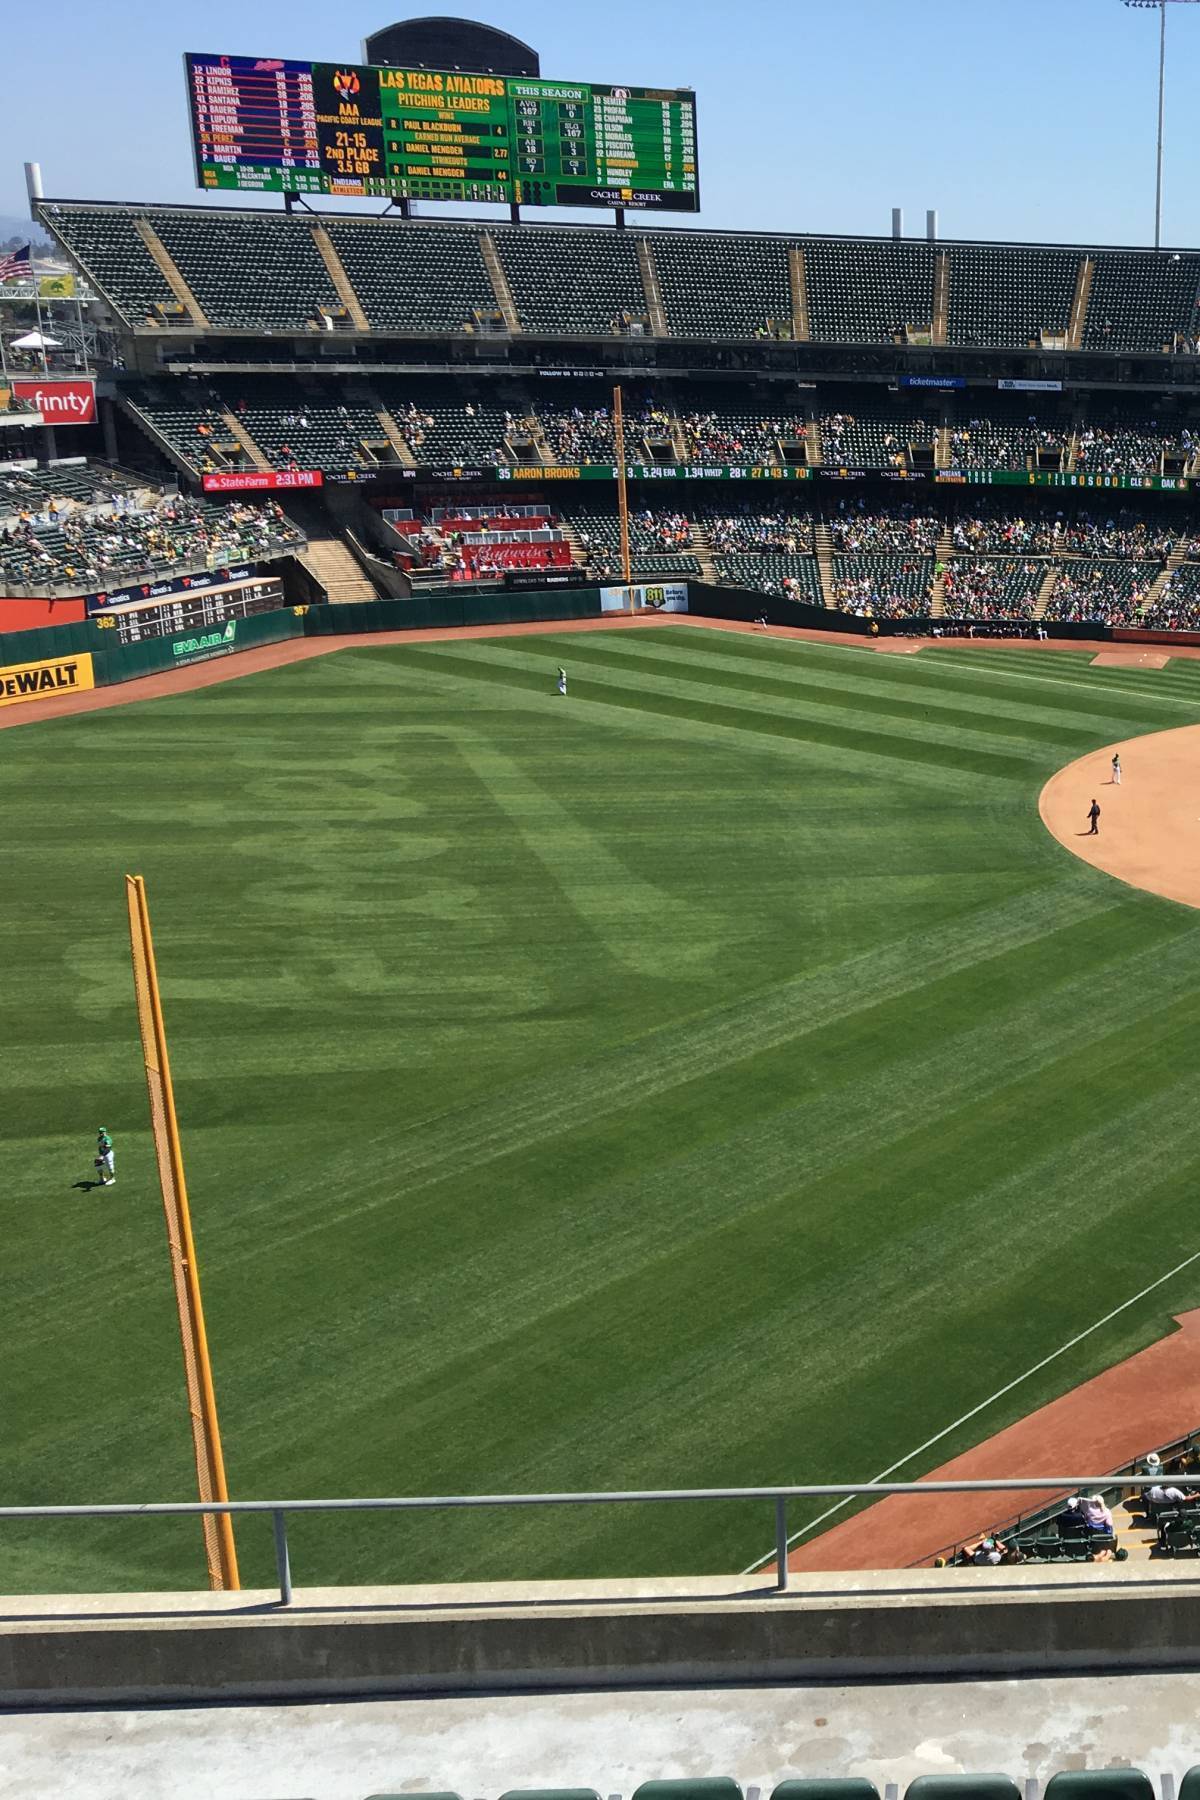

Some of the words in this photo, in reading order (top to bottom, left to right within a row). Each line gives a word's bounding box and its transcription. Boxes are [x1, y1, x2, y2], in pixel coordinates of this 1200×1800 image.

[194, 65, 203, 74] 12
[206, 66, 232, 76] LINDOR
[195, 76, 204, 84] 22
[206, 76, 232, 86] KIPNIS
[379, 70, 404, 89] LAS
[407, 72, 442, 91] VEGAS
[446, 76, 504, 96] AVIATORS
[196, 86, 204, 94] 11
[208, 86, 240, 96] RAMIREZ
[516, 86, 540, 96] THIS
[542, 88, 582, 99] SEASON
[196, 95, 206, 104] 41
[208, 96, 240, 105] SANTANA
[398, 92, 444, 108] PITCHING
[448, 96, 490, 111] LEADERS
[198, 104, 207, 113] 10
[210, 105, 236, 114] BAUERS
[339, 103, 360, 116] AAA
[210, 116, 238, 124] LUPLOW
[316, 114, 340, 124] PACIFIC
[340, 116, 359, 125] COAST
[360, 118, 383, 126] LEAGUE
[391, 120, 396, 128] R
[404, 120, 421, 130] PAUL
[422, 122, 462, 132] BLACKBURN
[212, 124, 244, 134] FREEMAN
[281, 129, 290, 137] SS
[213, 134, 234, 143] PEREZ
[336, 132, 366, 148] 21-15
[415, 132, 439, 142] EARNED
[440, 134, 454, 142] RUN
[455, 135, 480, 144] AVERAGE
[214, 145, 242, 154] MARTIN
[392, 142, 398, 151] R
[406, 144, 430, 153] DANIEL
[431, 145, 464, 156] MENGDEN
[494, 148, 508, 158] 2.77
[606, 142, 634, 150] PISCOTTY
[326, 146, 344, 160] 2ND
[347, 148, 379, 161] PLACE
[606, 150, 635, 158] LAUREANO
[214, 154, 237, 164] BAUER
[282, 158, 296, 166] ERA
[338, 160, 353, 173] 3.5
[355, 161, 370, 174] GB
[394, 165, 400, 174] R
[408, 166, 431, 176] DANIEL
[432, 167, 464, 178] MENGDEN
[498, 172, 506, 180] 44
[606, 168, 632, 177] HUNDLEY
[332, 178, 362, 186] INDIANS
[590, 190, 620, 199] CACHE
[910, 377, 954, 387] ticketmaster
[27, 390, 90, 416] finity
[498, 468, 510, 479] 35
[513, 468, 542, 479] AARON
[544, 468, 580, 479] BROOKS
[642, 468, 662, 478] 5.24
[663, 468, 676, 477] ERA
[684, 467, 704, 478] 1.34
[704, 468, 722, 477] WHIP
[730, 468, 741, 478] 28
[742, 469, 746, 477] K
[752, 468, 762, 478] 27
[764, 469, 770, 477] B
[771, 468, 782, 478] 43
[784, 469, 788, 477] S
[276, 474, 296, 486] 2:31
[298, 473, 314, 484] PM
[1030, 473, 1034, 484] 5
[1071, 476, 1077, 486] B
[1088, 477, 1094, 486] S
[1130, 478, 1142, 487] CLE
[1162, 479, 1176, 488] OAK
[228, 570, 249, 580] Fanatics
[646, 588, 663, 600] 811
[294, 605, 310, 616] 367
[97, 616, 116, 628] 362
[173, 638, 200, 655] EVA
[200, 632, 222, 648] AIR
